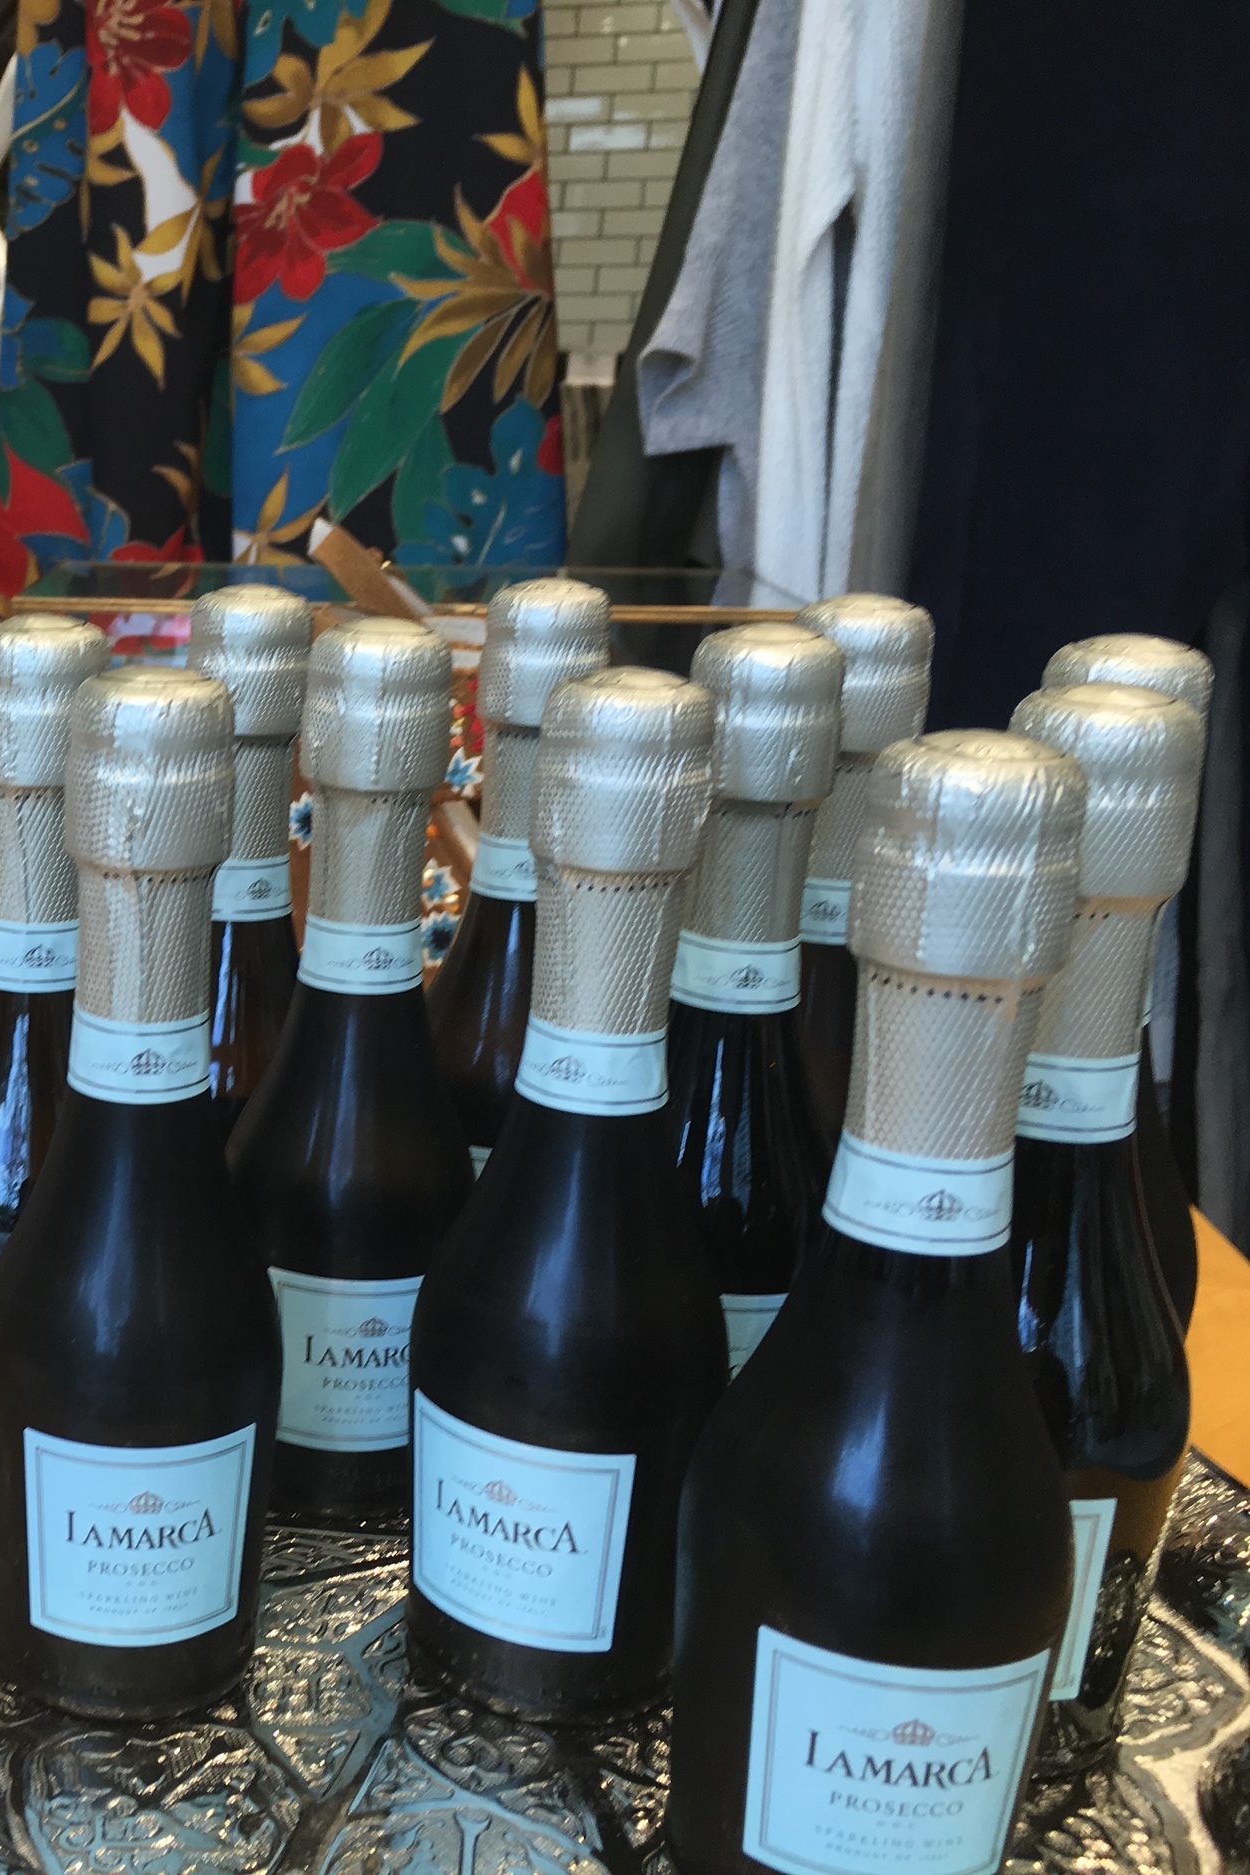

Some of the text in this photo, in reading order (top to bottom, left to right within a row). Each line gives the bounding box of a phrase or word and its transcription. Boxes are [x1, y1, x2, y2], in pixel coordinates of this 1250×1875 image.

[86, 1556, 195, 1577] PROSECCO
[449, 1531, 554, 1579] PROSECCO
[829, 1789, 965, 1818] PROSECCO
